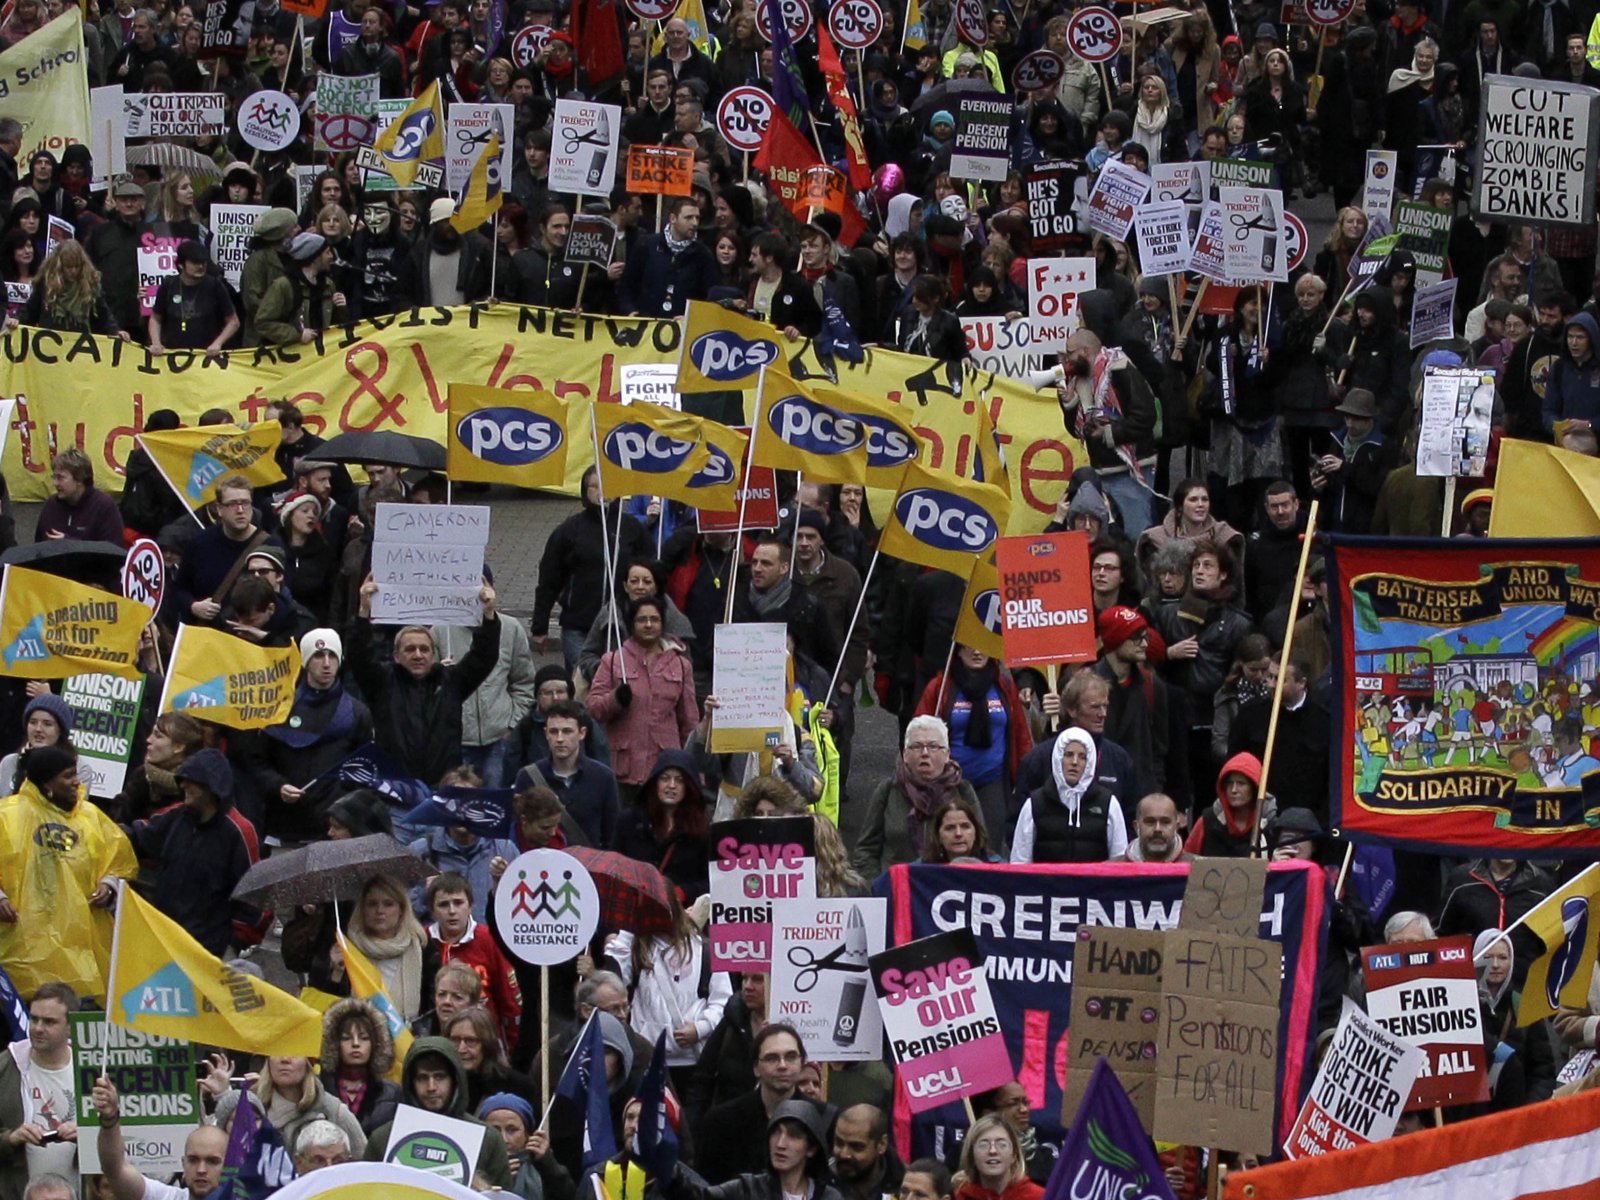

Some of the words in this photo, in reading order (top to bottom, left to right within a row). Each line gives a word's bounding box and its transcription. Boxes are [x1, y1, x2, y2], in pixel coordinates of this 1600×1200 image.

[217, 31, 232, 46] GO
[151, 95, 173, 109] CUT
[174, 95, 225, 109] TRIDENT
[960, 100, 1013, 114] EVERYONE
[1512, 89, 1572, 114] CUT
[151, 110, 175, 122] NOT
[178, 109, 206, 122] OUR
[454, 119, 491, 128] TRIDENT
[473, 110, 490, 120] CUT
[560, 117, 596, 128] TRIDENT
[580, 109, 597, 118] CUT
[967, 123, 1009, 138] DECENT
[1486, 112, 1575, 141] WELFARE
[956, 135, 1007, 150] PENSION
[633, 155, 688, 170] STRIKE
[1485, 139, 1586, 172] SCROUNGING
[632, 169, 672, 183] BACK
[1174, 169, 1190, 178] CUT
[1212, 162, 1271, 185] UNISON
[1483, 166, 1567, 191] ZOMBIE
[1028, 179, 1059, 200] HE'S
[1244, 195, 1260, 203] CUT
[1029, 198, 1057, 219] GOT
[1225, 203, 1260, 212] TRIDENT
[1488, 186, 1581, 219] BANKS!
[1031, 219, 1049, 237] TO
[1053, 215, 1073, 233] GO
[1399, 207, 1452, 231] UNISON
[218, 235, 234, 248] UP
[572, 232, 602, 241] SHUT
[1396, 223, 1432, 239] FIGHTING
[571, 240, 609, 252] DOWN
[703, 340, 769, 377] pcs
[781, 402, 857, 445] pcs
[471, 415, 553, 458] pcs
[190, 462, 226, 490] ATL
[387, 511, 480, 531] CAMERON
[905, 495, 988, 546] pcs
[386, 548, 469, 565] MAXWELL
[1029, 543, 1056, 555] pcs
[412, 573, 461, 584] THICK
[1004, 570, 1062, 586] HANDS
[1377, 580, 1483, 606] BATTERSEA
[1508, 568, 1549, 586] AND
[383, 592, 434, 607] PENSION
[1004, 584, 1035, 600] OFF
[47, 598, 118, 625] speaking
[1005, 598, 1043, 615] OUR
[1397, 602, 1461, 622] TRADES
[1503, 585, 1560, 603] UNION
[1006, 609, 1089, 629] PENSIONS
[46, 622, 68, 643] out
[72, 620, 100, 646] for
[15, 640, 45, 660] ATL
[66, 674, 142, 700] UNISON
[63, 691, 112, 712] FIGHTING
[114, 702, 135, 715] FOR
[1378, 779, 1513, 801] SOLIDARITY
[1536, 800, 1561, 821] IN
[717, 837, 805, 872] Save
[742, 873, 804, 899] our
[1196, 867, 1251, 921] SO
[816, 911, 844, 926] CUT
[513, 924, 574, 935] COALITION
[513, 934, 579, 946] RESISTANCE
[783, 926, 843, 941] TRIDENT
[713, 937, 766, 962] ucu
[1374, 957, 1395, 969] ATL
[1409, 953, 1430, 966] NUT
[1439, 949, 1466, 961] ucu
[1175, 939, 1272, 998] FAIR
[880, 956, 972, 1007] Save
[140, 986, 188, 1014] ATL
[779, 1000, 812, 1014] NOT:
[917, 984, 977, 1027] our
[1398, 986, 1449, 1012] FAIR
[893, 1015, 999, 1062] Pensions
[1373, 1031, 1405, 1057] Worker
[78, 1050, 153, 1067] FIGHTING
[158, 1049, 190, 1065] FOR
[1339, 1027, 1399, 1085] STRIKE
[1437, 1050, 1476, 1077] ALL
[907, 1066, 961, 1099] ucu
[1174, 1055, 1218, 1105] FOR
[1222, 1059, 1259, 1112] ALL
[1323, 1042, 1401, 1119] TOGETHER
[1316, 1077, 1337, 1115] TO
[1335, 1094, 1377, 1138] WIN
[1308, 1109, 1333, 1143] Kick
[427, 1148, 448, 1161] NUT
